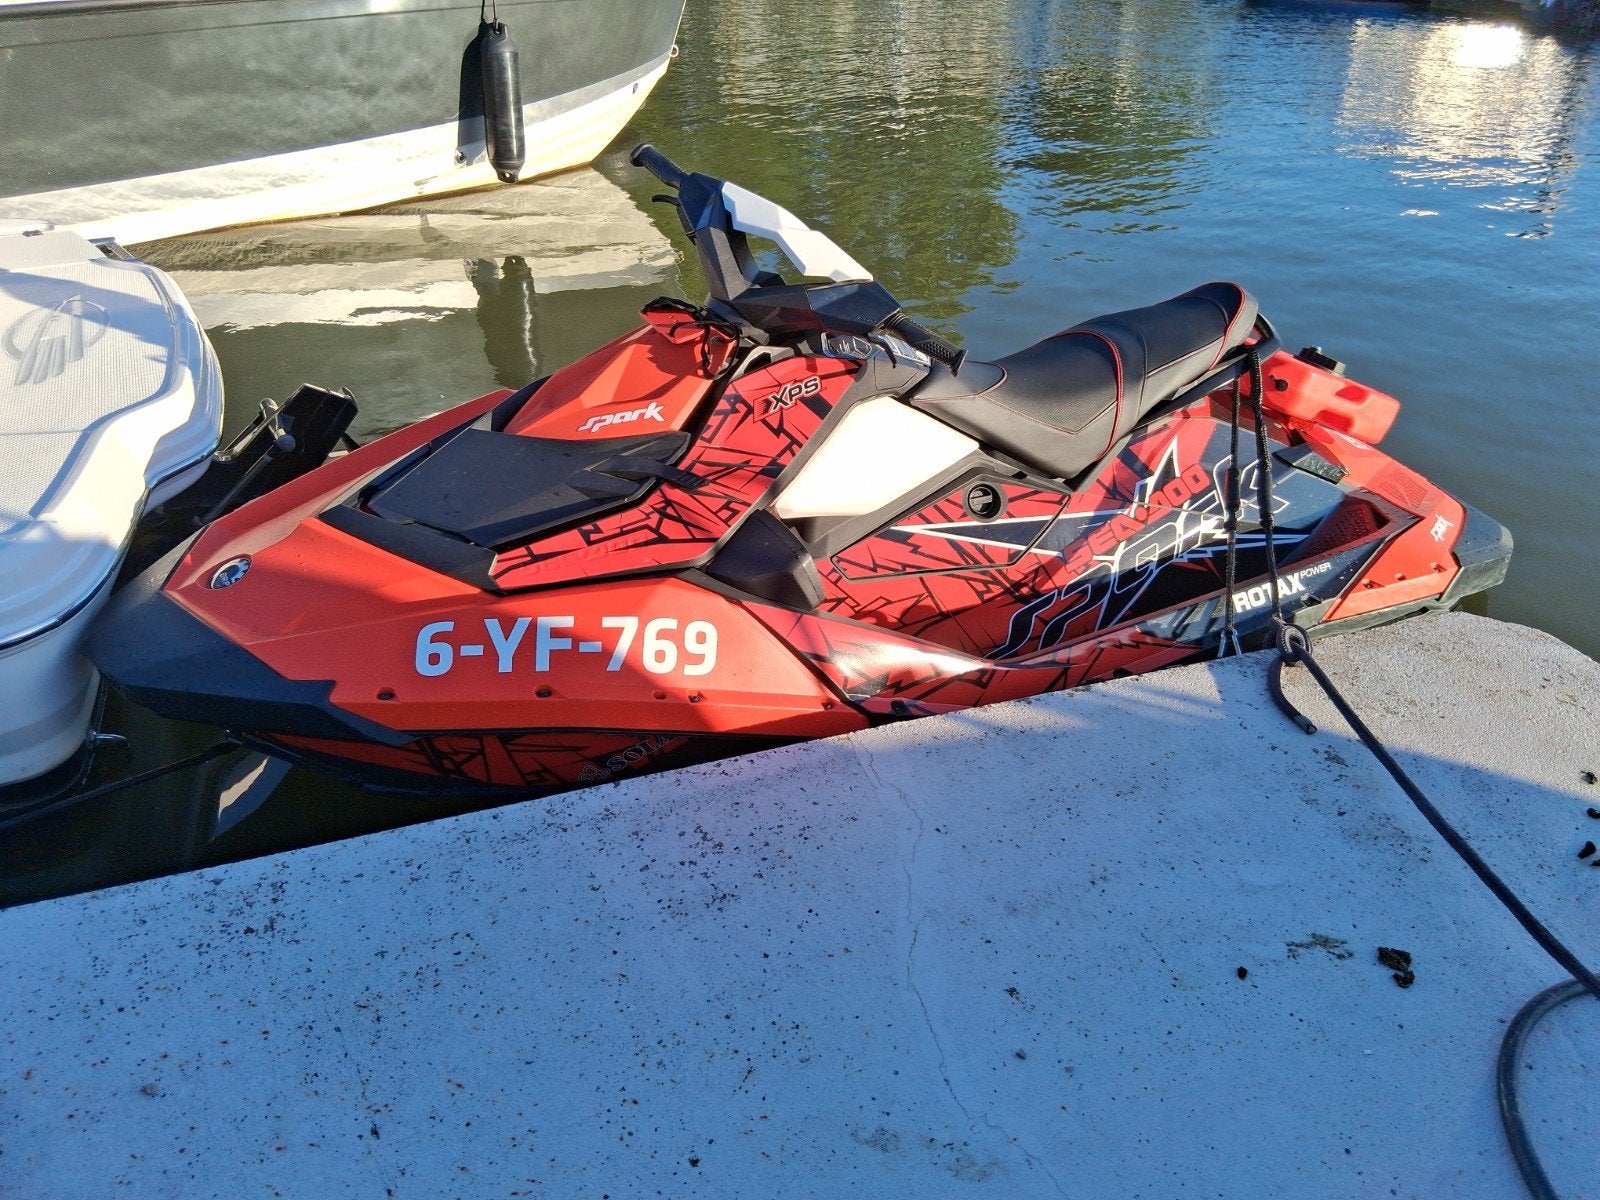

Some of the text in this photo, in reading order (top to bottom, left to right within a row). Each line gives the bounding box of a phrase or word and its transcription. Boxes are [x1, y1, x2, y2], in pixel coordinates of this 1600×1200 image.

[769, 376, 821, 413] XPS
[578, 401, 667, 434] spark
[1300, 562, 1332, 580] POWER
[415, 616, 719, 677] 6-YF-769
